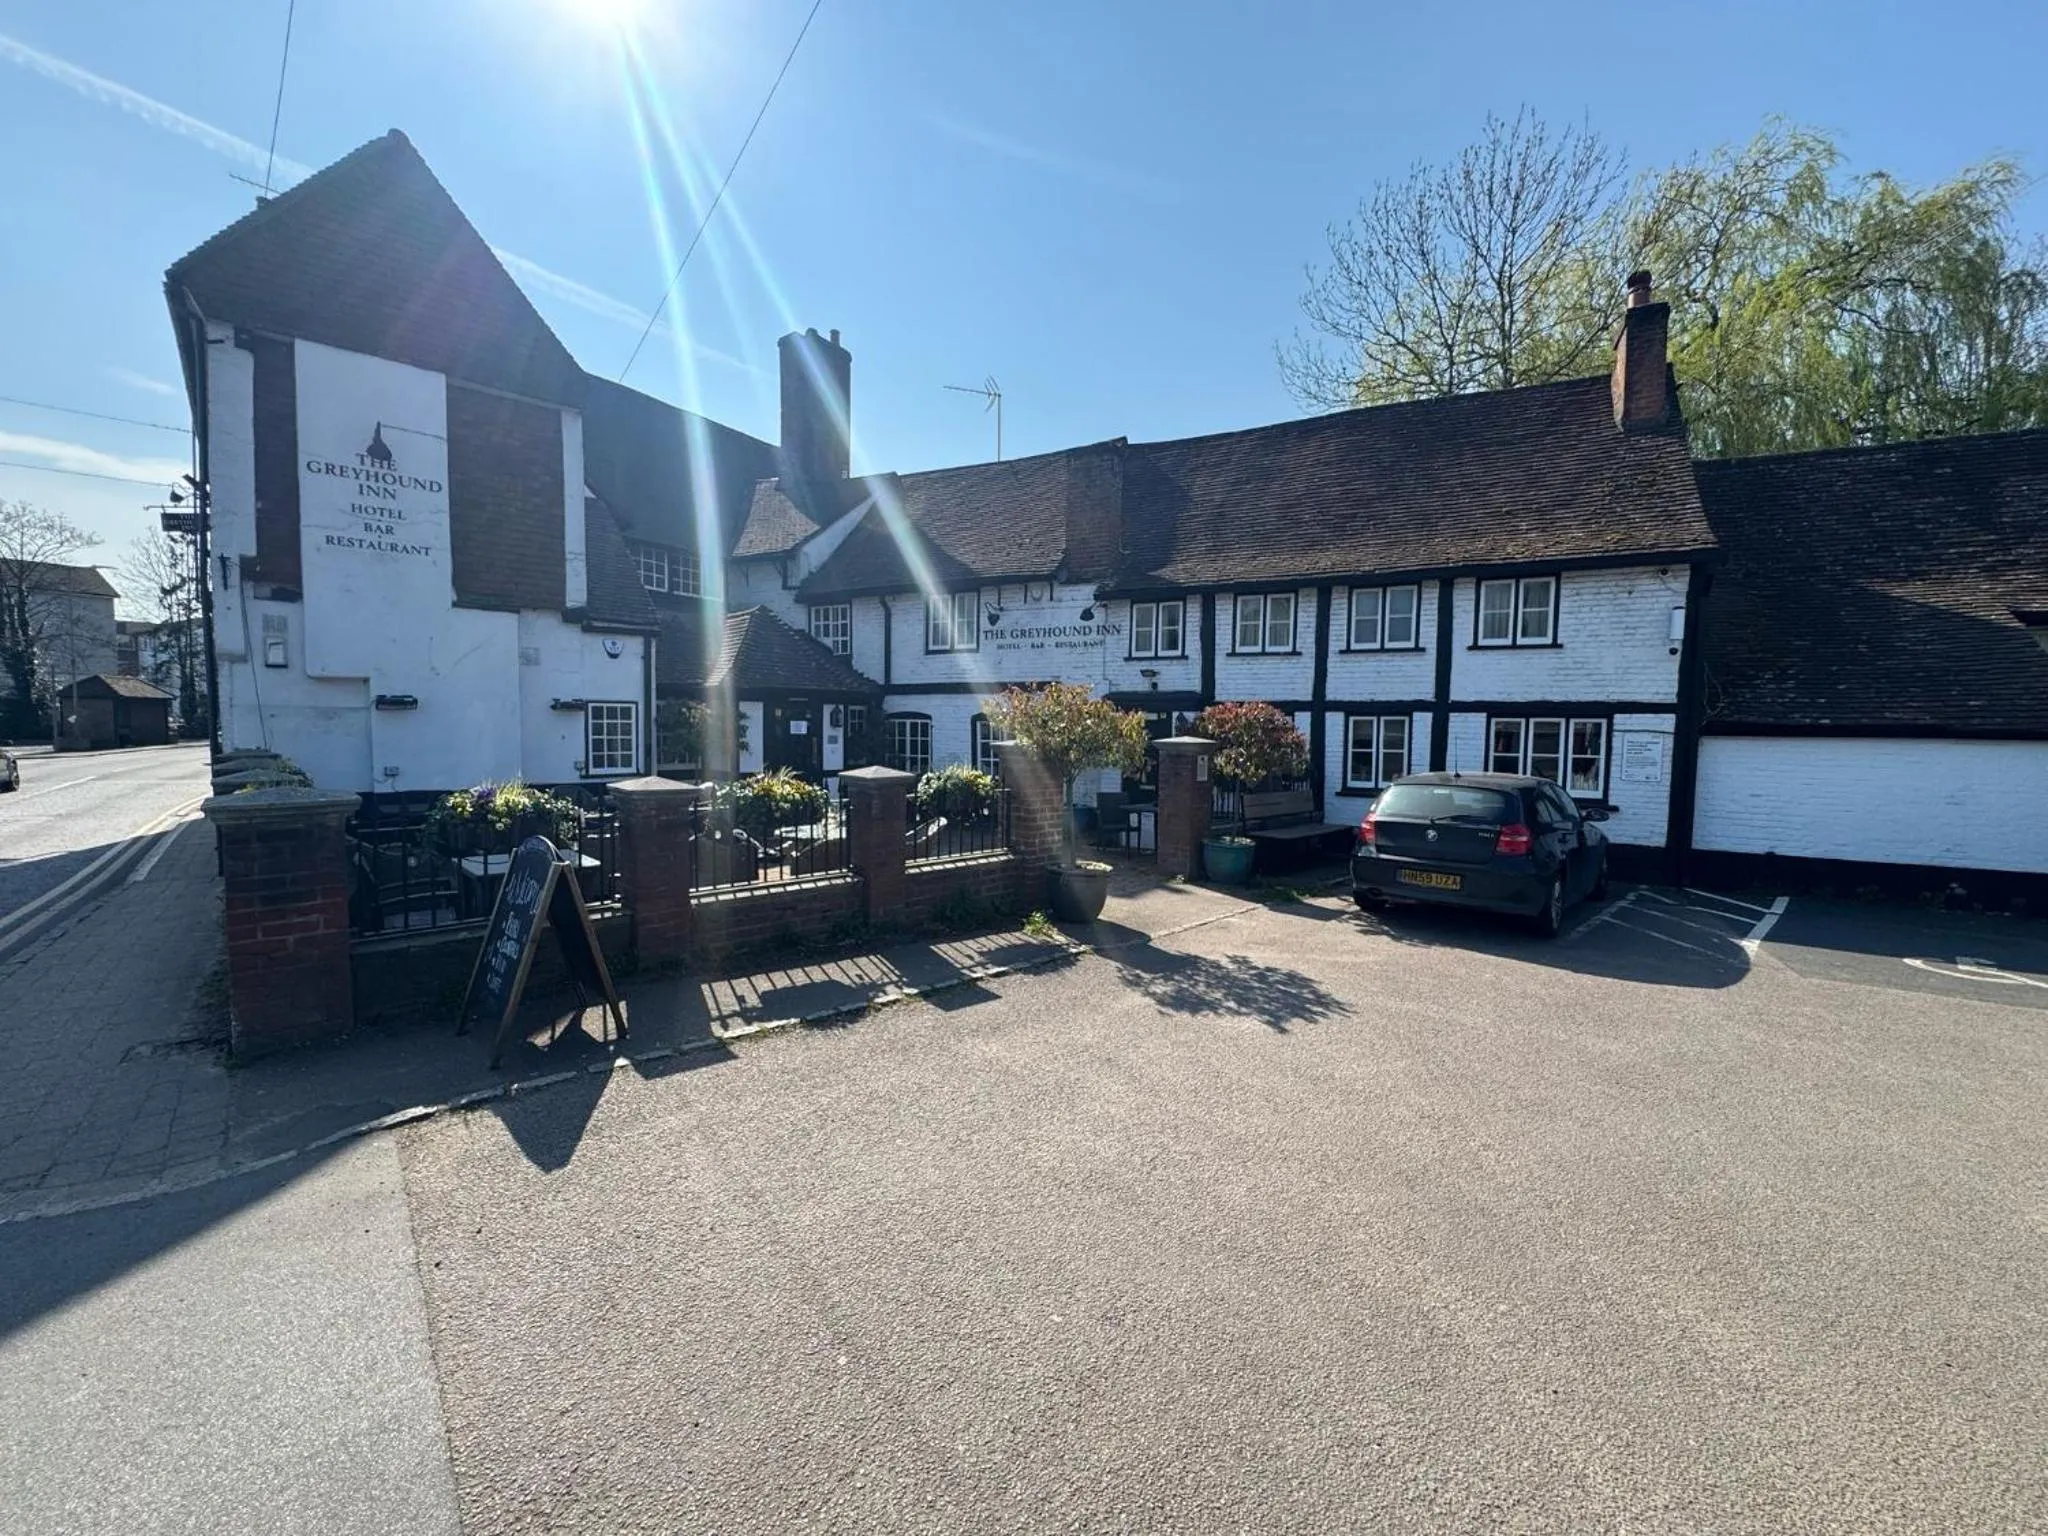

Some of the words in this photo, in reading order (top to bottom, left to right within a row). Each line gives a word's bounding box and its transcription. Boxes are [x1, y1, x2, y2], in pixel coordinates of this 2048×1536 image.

[355, 453, 398, 471] THE
[306, 461, 443, 493] GREYHOUND
[358, 483, 397, 500] INN
[351, 503, 408, 520] HOTEL
[364, 522, 395, 535] BAR
[325, 535, 432, 557] RESTAURANT
[983, 630, 1006, 640] THE
[1010, 625, 1092, 640] GREYHOUND
[1096, 624, 1122, 636] INN
[996, 642, 1021, 651] HOTEL
[1030, 641, 1045, 649] BAR
[1055, 639, 1104, 649] RESTAURANT
